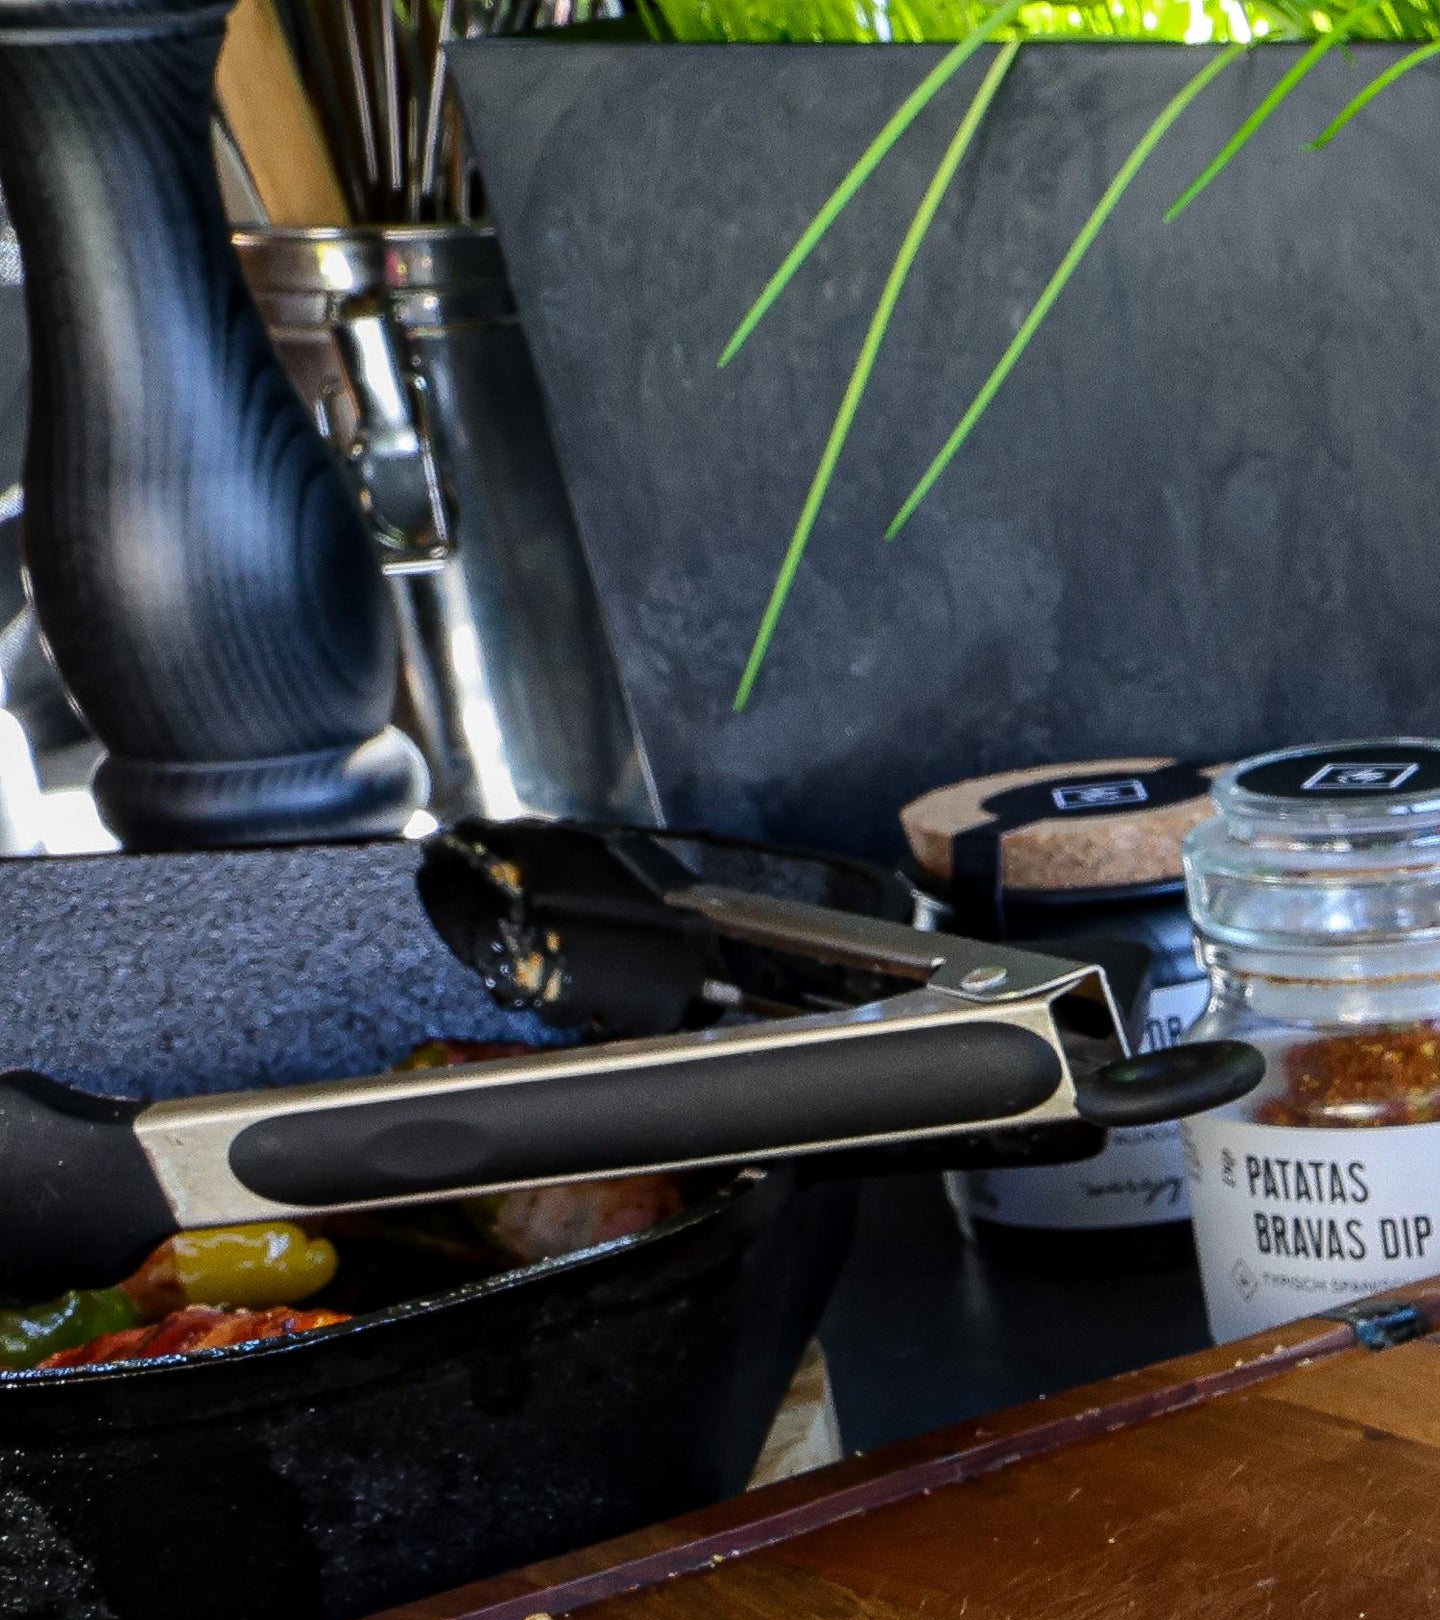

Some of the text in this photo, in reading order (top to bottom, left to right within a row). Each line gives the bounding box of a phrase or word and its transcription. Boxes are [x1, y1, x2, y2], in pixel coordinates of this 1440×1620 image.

[1246, 1153, 1369, 1204] PATATAS
[1254, 1211, 1434, 1261] BRAVAS DIP
